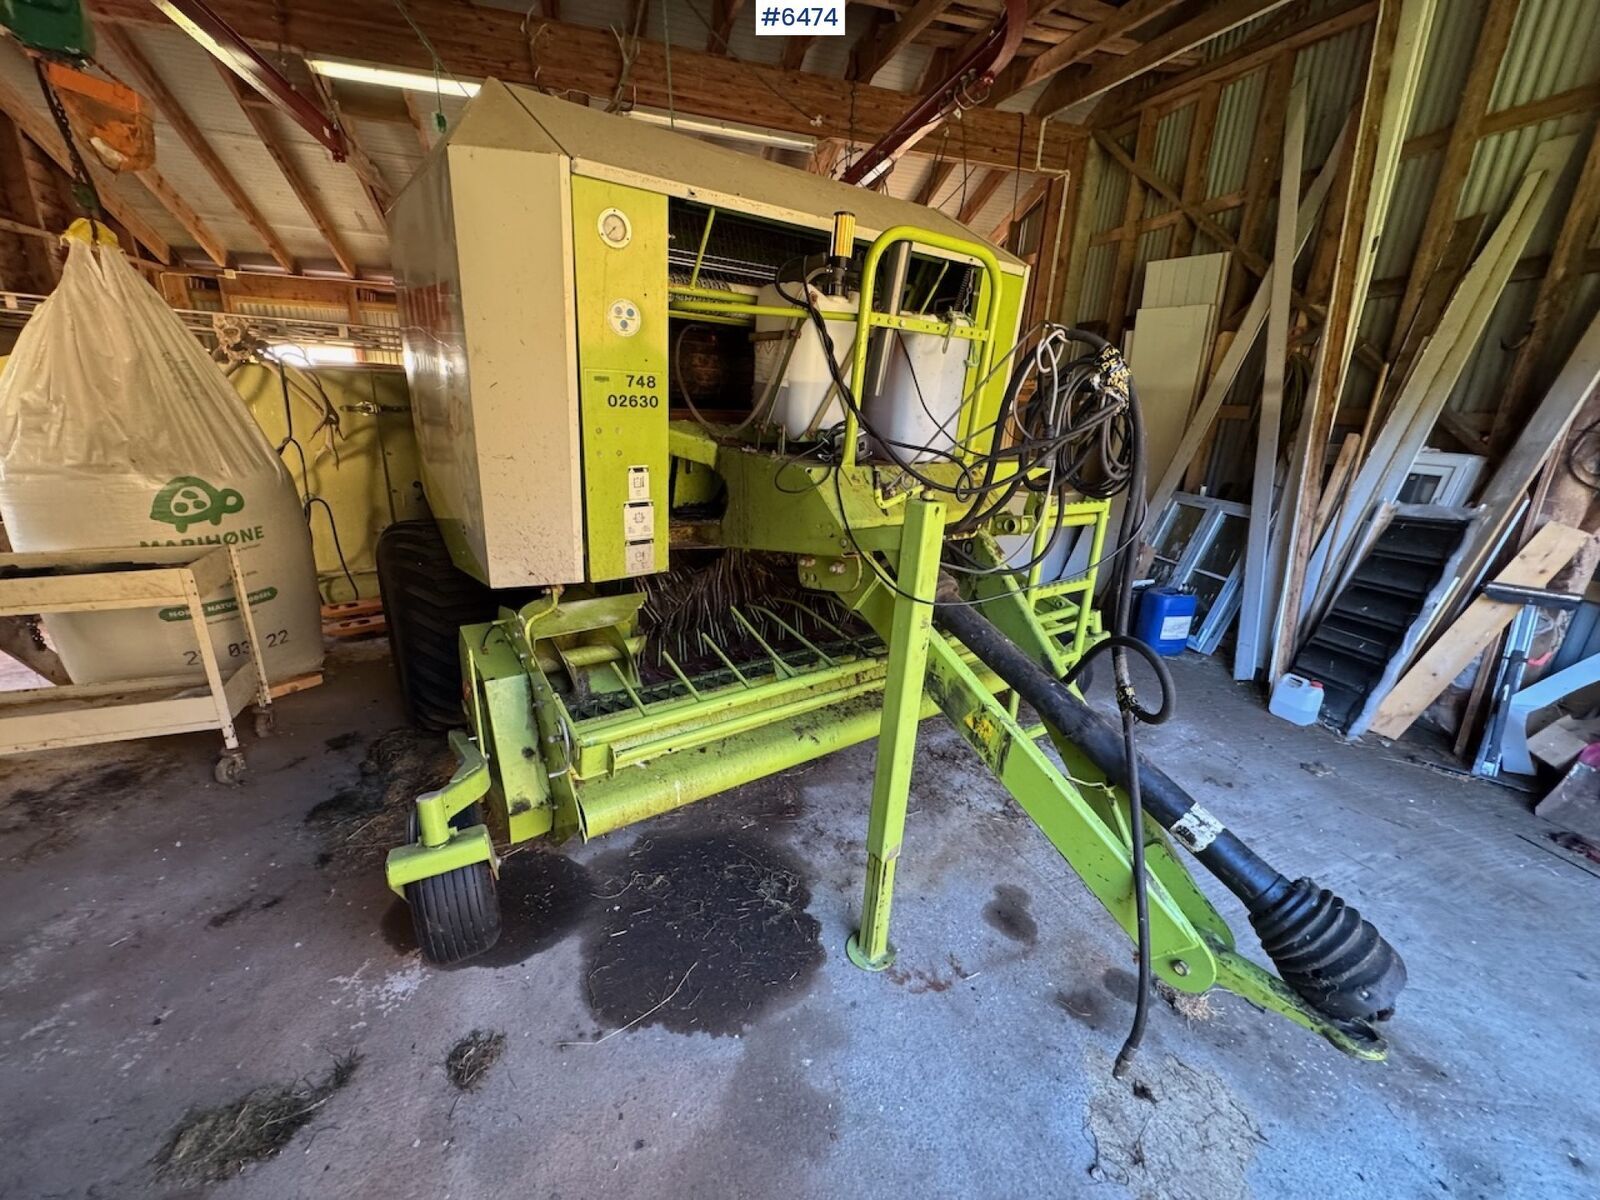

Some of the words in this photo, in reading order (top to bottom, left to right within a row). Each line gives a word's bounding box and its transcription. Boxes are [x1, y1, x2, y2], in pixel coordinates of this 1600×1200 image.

[626, 375, 656, 389] 748
[608, 394, 659, 408] 02630
[183, 649, 201, 666] 2
[266, 629, 289, 648] 22
